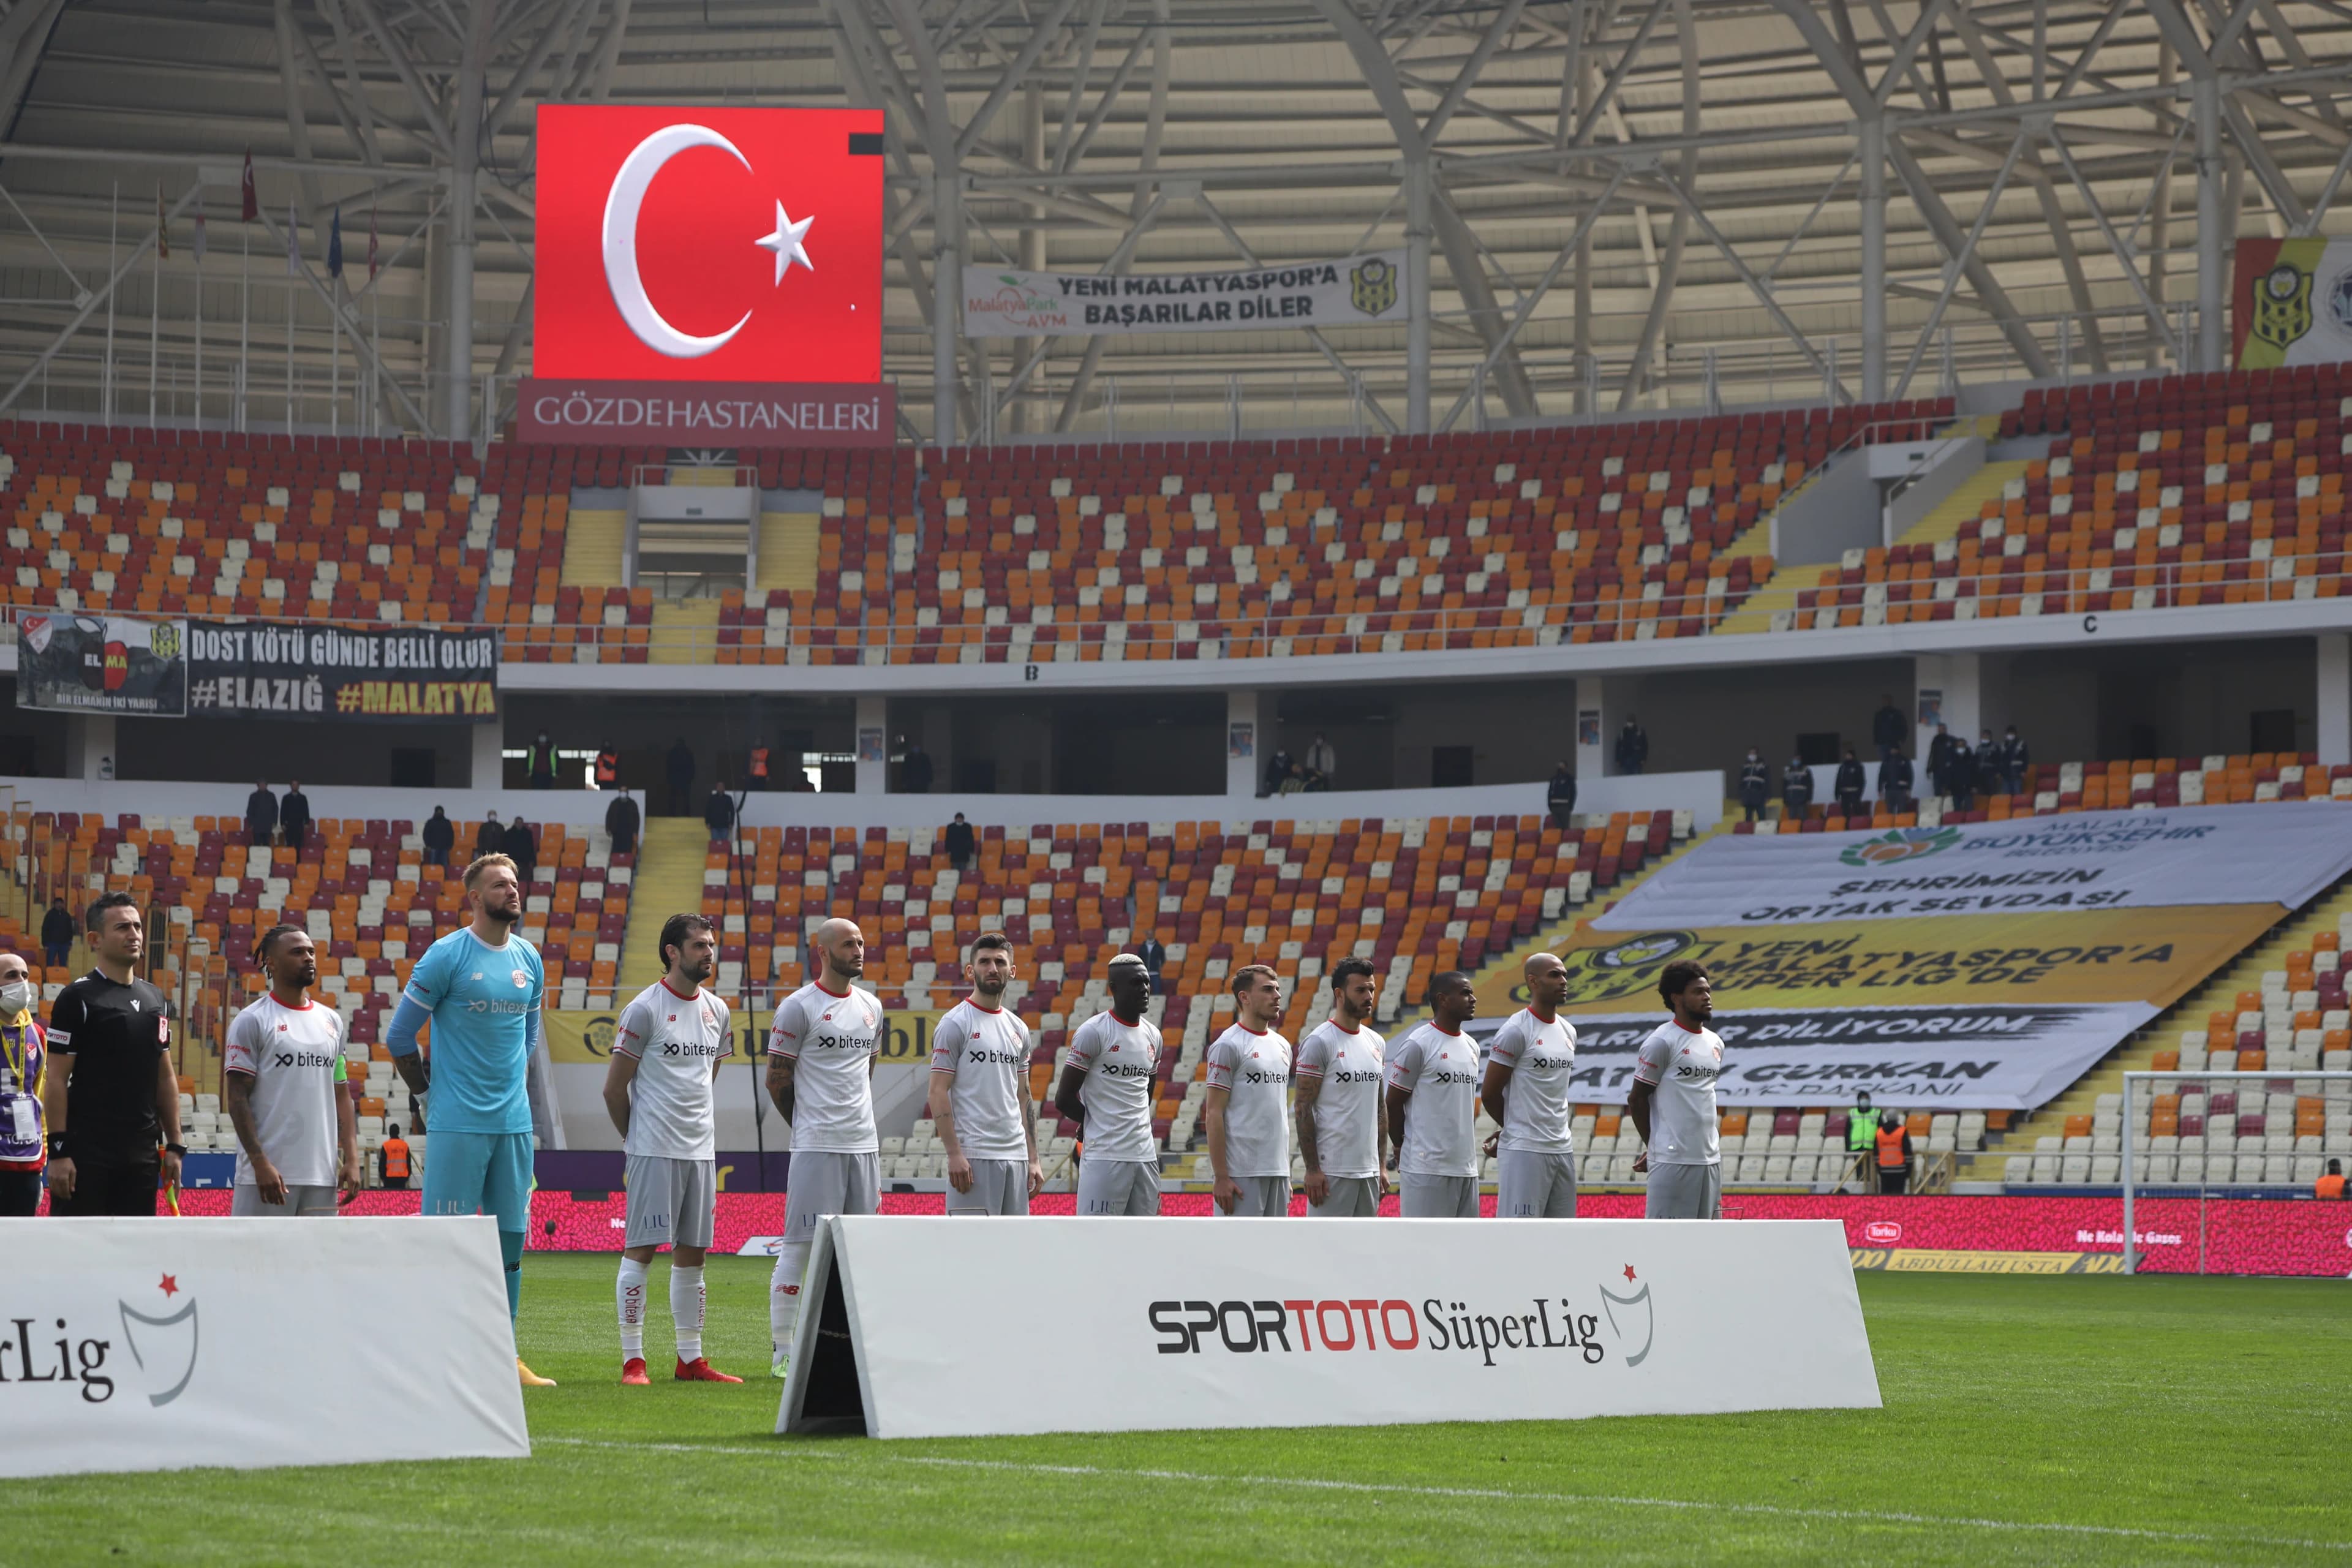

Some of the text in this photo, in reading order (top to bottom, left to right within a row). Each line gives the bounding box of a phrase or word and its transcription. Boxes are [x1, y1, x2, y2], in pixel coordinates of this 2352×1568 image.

[1058, 265, 1339, 297] YENİ MALATYASPOR'A
[1026, 314, 1067, 328] AVM
[1085, 295, 1314, 328] BAŞARILAR DİLER
[2084, 616, 2098, 633] C
[192, 628, 493, 669] DOST KÖTÜ GÜNDE BELLİ OLUR
[1025, 665, 1038, 680] B
[192, 675, 496, 715] #ELAZIĞ #MALATYA
[1829, 867, 2105, 899] ŞEHRİMİZİN
[1741, 889, 2133, 922] ORTAK SEVDASI
[1733, 932, 1863, 959] YENİ
[1747, 1014, 2034, 1041] DİLİYORUM
[839, 1035, 874, 1049] bitexe
[1871, 1226, 1897, 1237] Torku
[1894, 1258, 2062, 1274] ABDULLAH USTA
